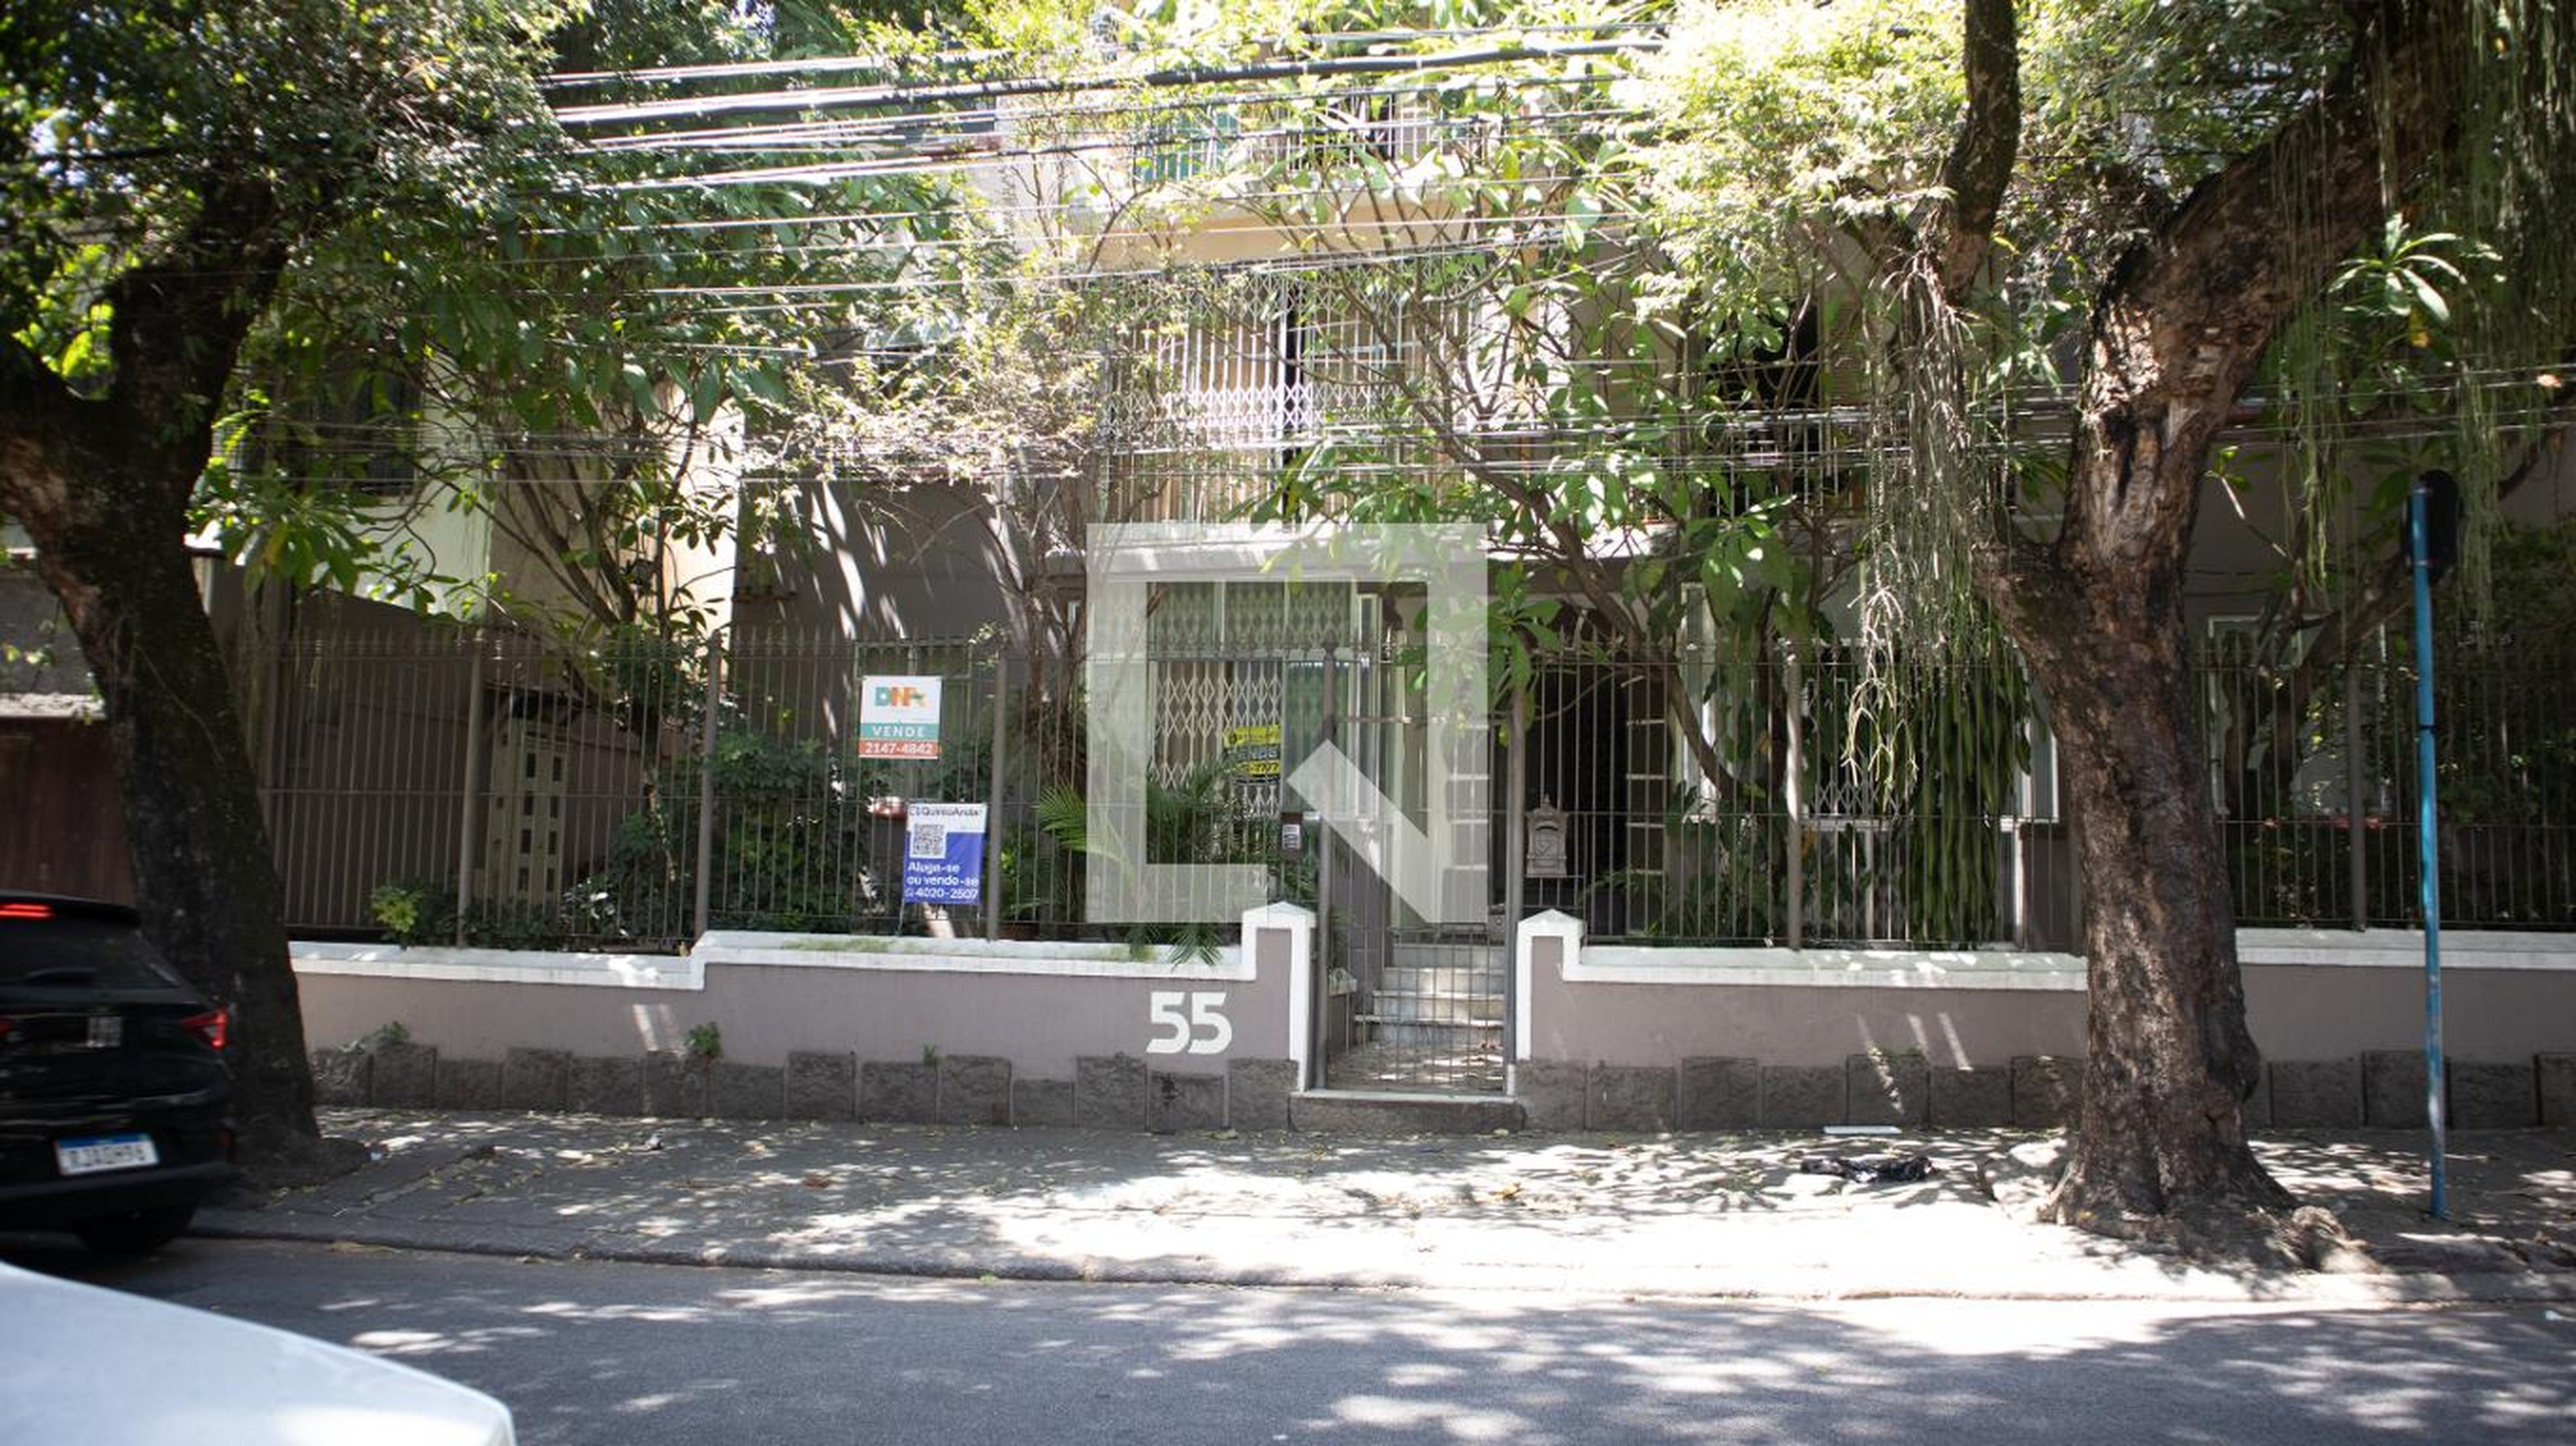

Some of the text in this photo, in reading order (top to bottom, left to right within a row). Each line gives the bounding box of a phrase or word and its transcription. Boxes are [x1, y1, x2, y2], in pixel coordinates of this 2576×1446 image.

[873, 726, 926, 737] VENDE
[865, 742, 933, 754] 2147-4842
[907, 875, 979, 887] ou vende-se
[1146, 992, 1232, 1054] 55
